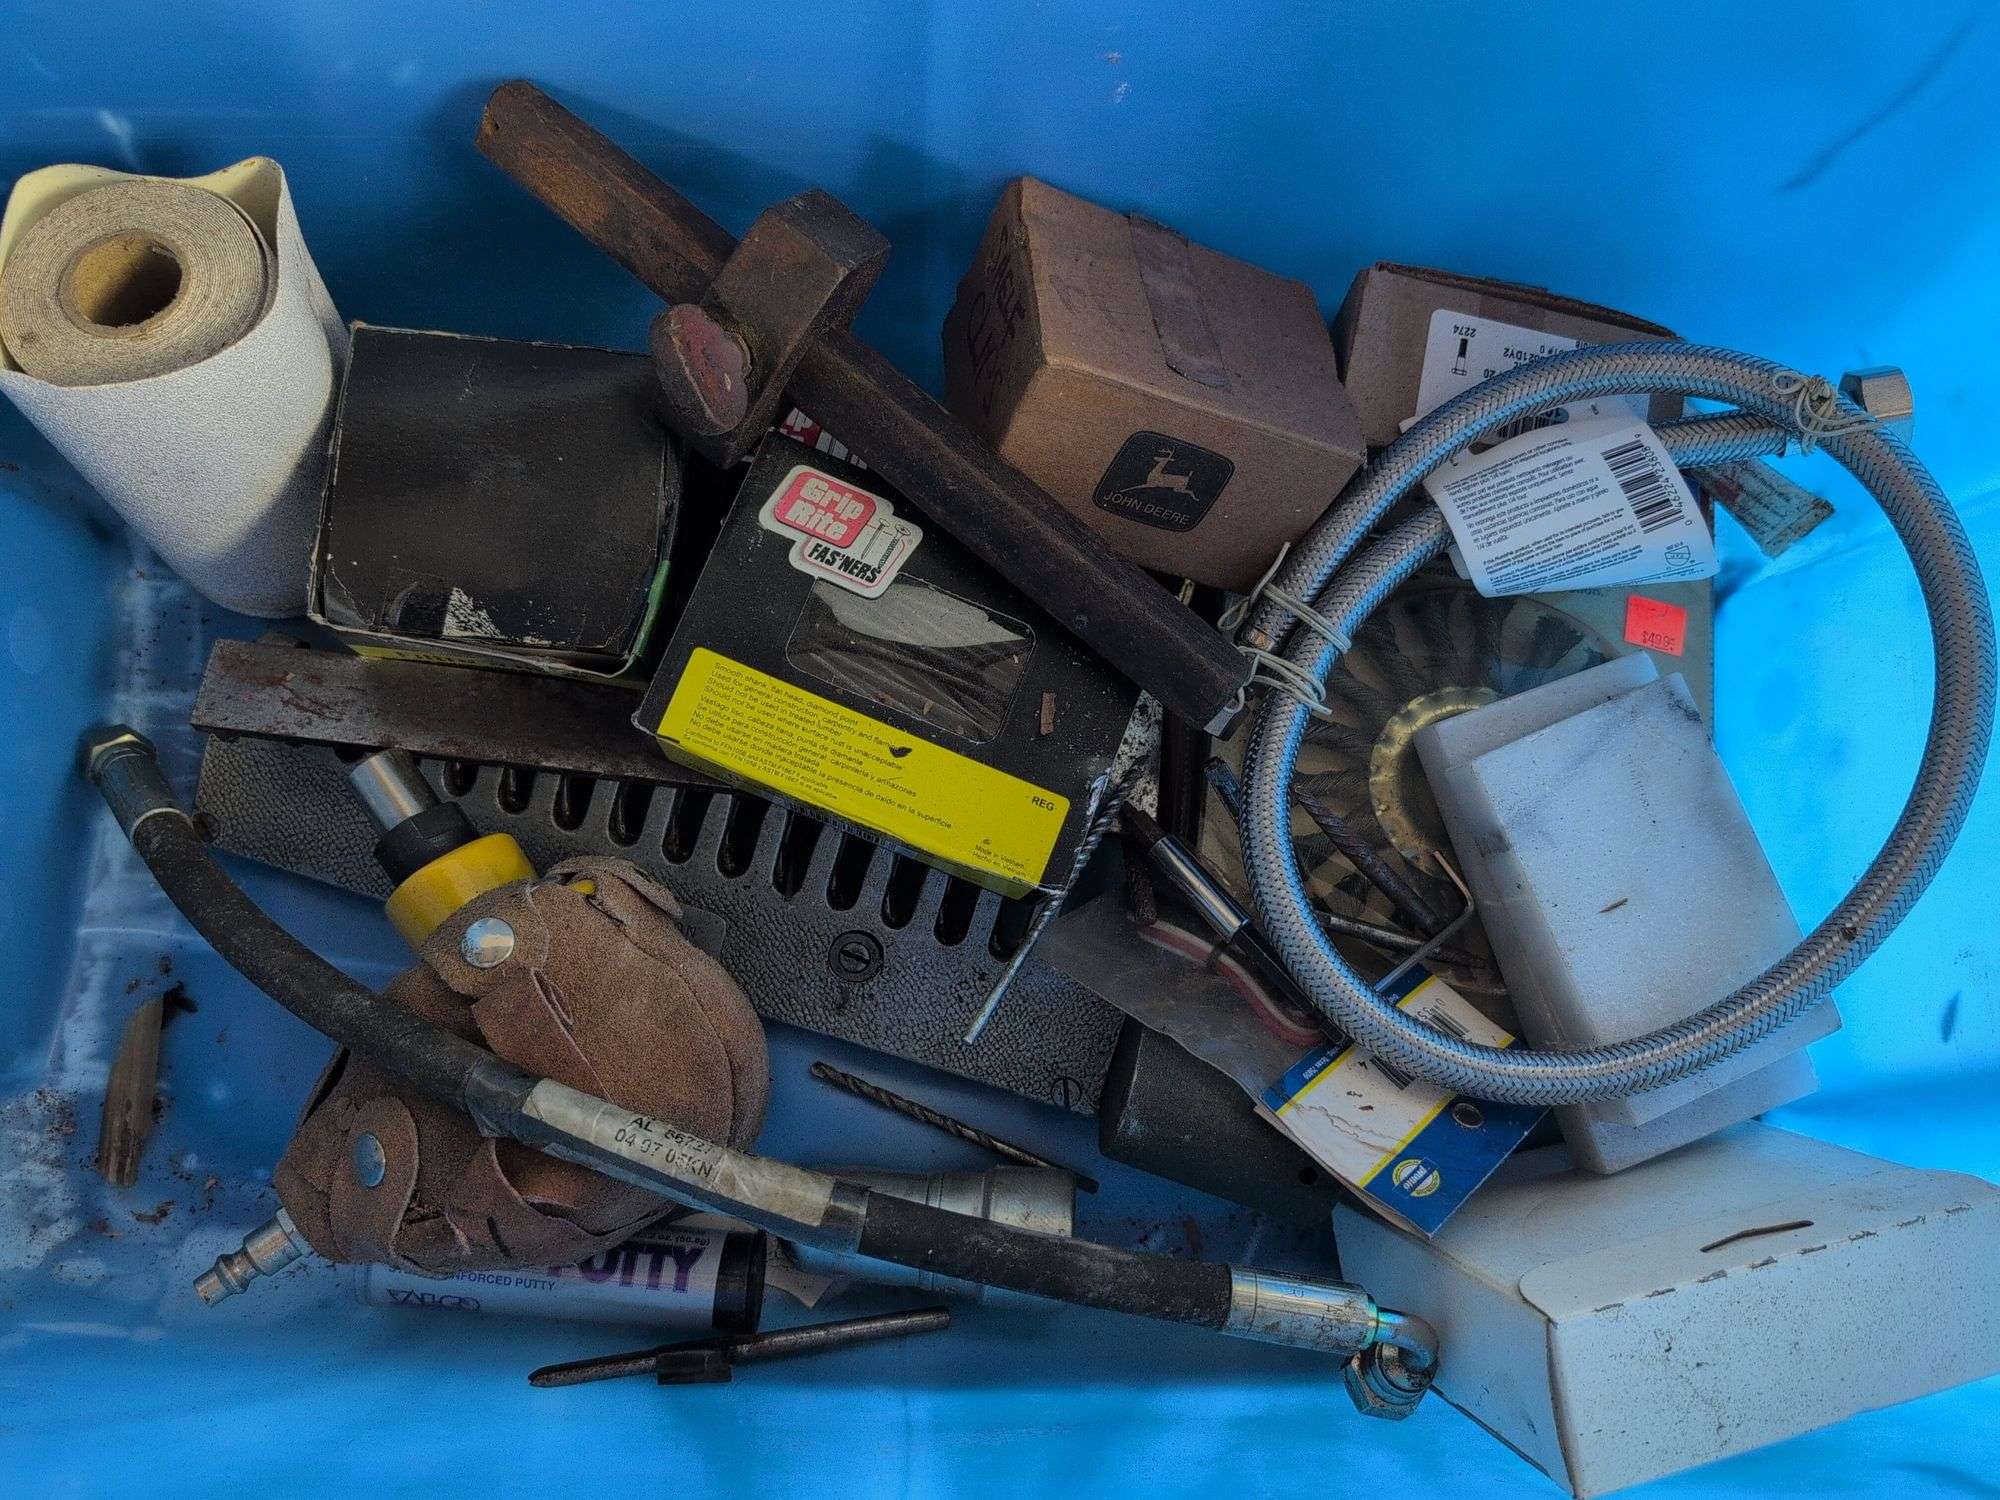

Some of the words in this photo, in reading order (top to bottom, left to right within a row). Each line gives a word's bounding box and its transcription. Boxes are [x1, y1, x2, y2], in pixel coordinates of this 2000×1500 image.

[1452, 324, 1476, 337] 2274
[800, 475, 871, 523] Grip
[1103, 491, 1143, 513] JOHN
[1144, 500, 1192, 525] DEERE
[1660, 476, 1684, 510] 46224
[785, 500, 848, 541] Rite
[807, 542, 882, 584] FAS'NERS
[1030, 795, 1056, 812] REG
[630, 1114, 655, 1133] AL
[514, 1276, 557, 1291] PUTTY
[548, 1245, 704, 1292] UTTY
